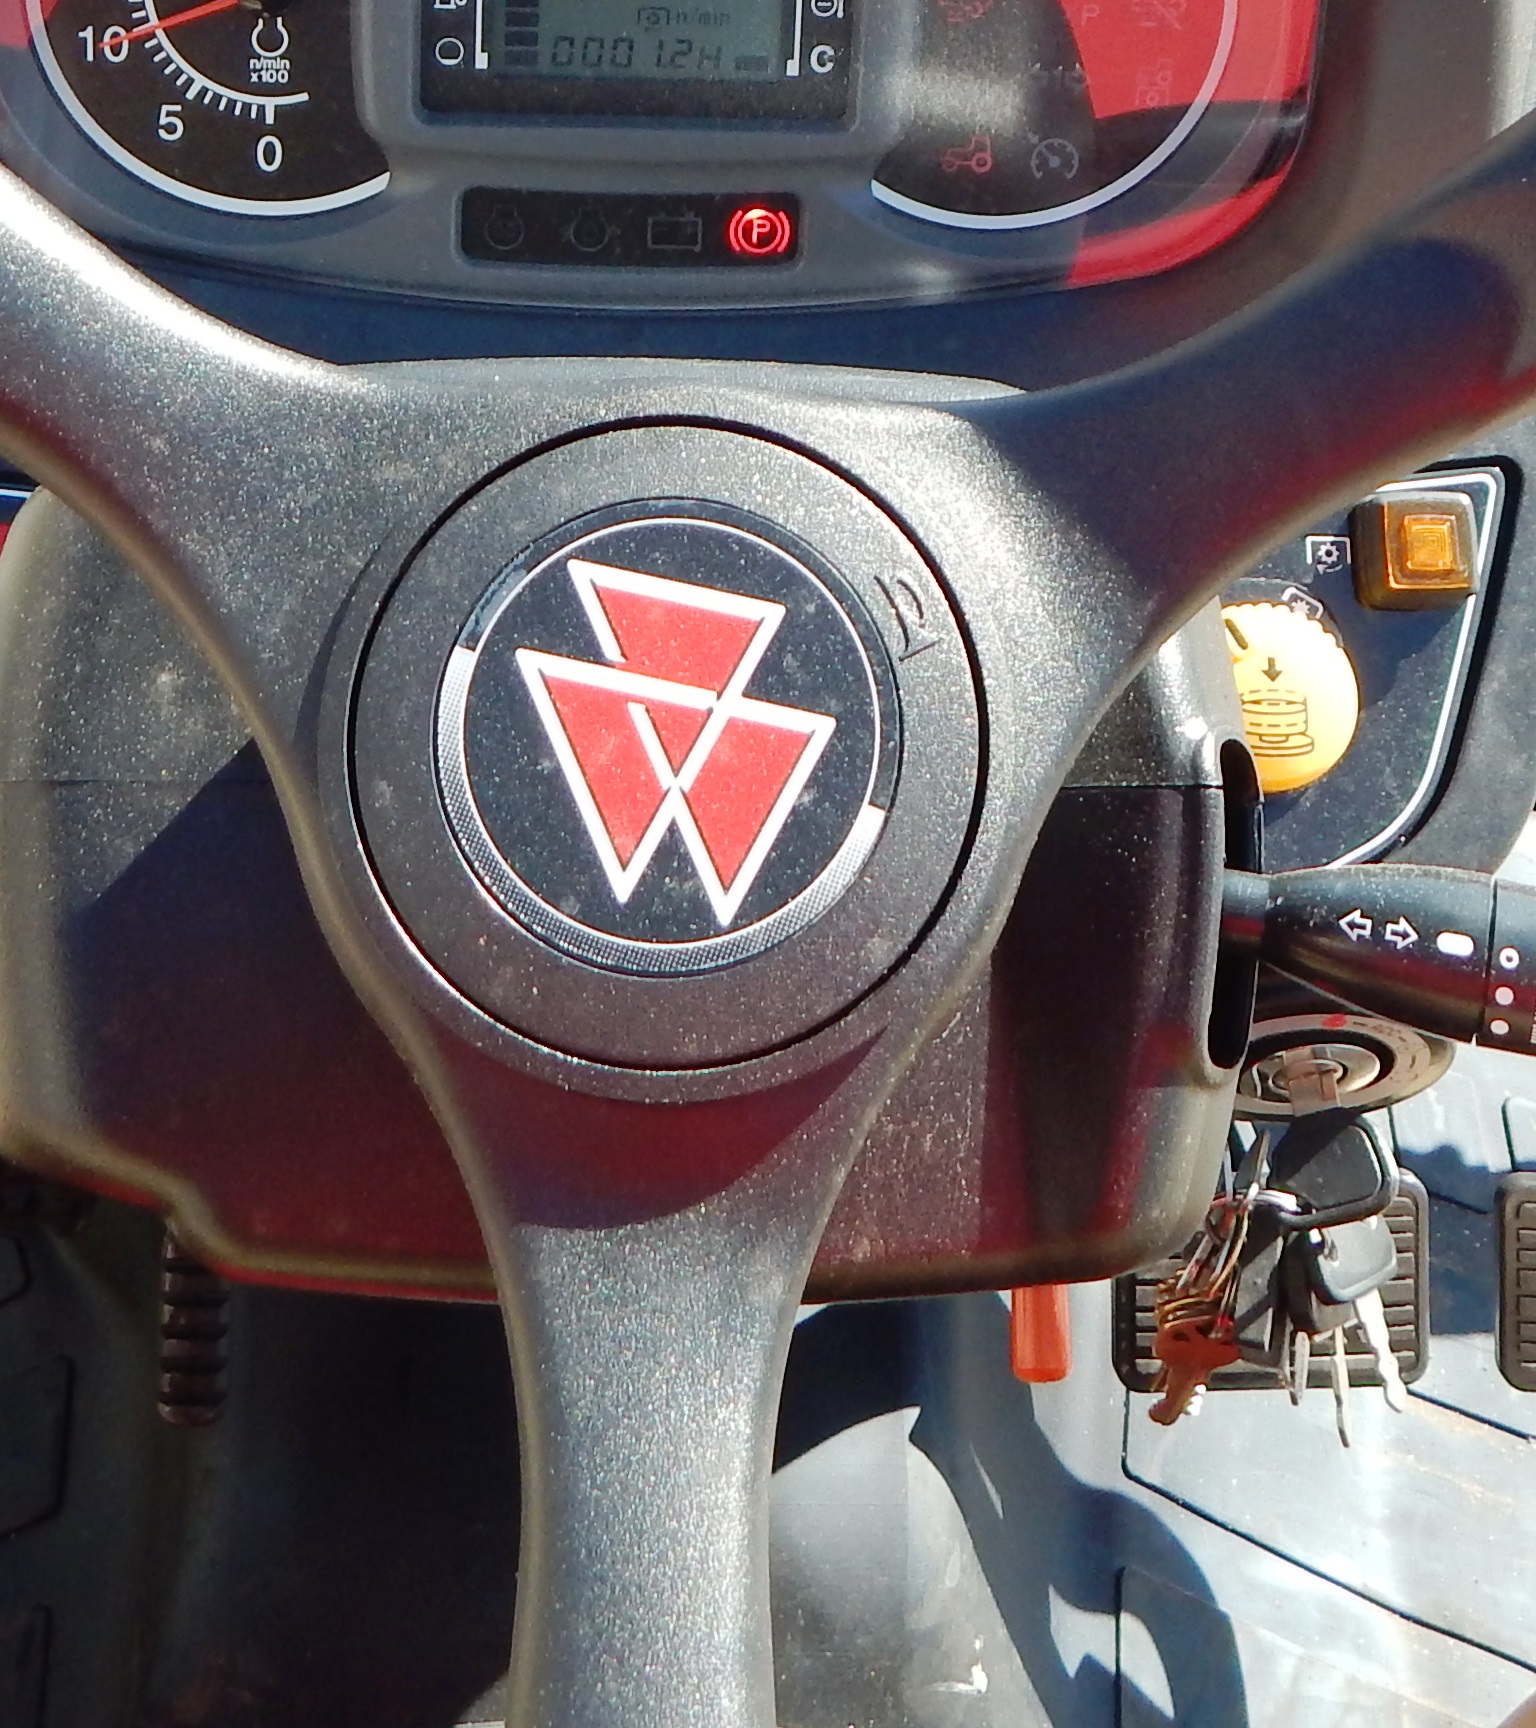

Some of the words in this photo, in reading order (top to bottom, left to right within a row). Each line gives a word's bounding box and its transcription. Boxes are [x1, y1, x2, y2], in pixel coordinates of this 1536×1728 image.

[78, 27, 129, 63] 10
[810, 45, 835, 73] C
[249, 57, 290, 70] n/min
[250, 69, 289, 84] x100
[158, 105, 184, 140] 5
[256, 136, 283, 172] 0
